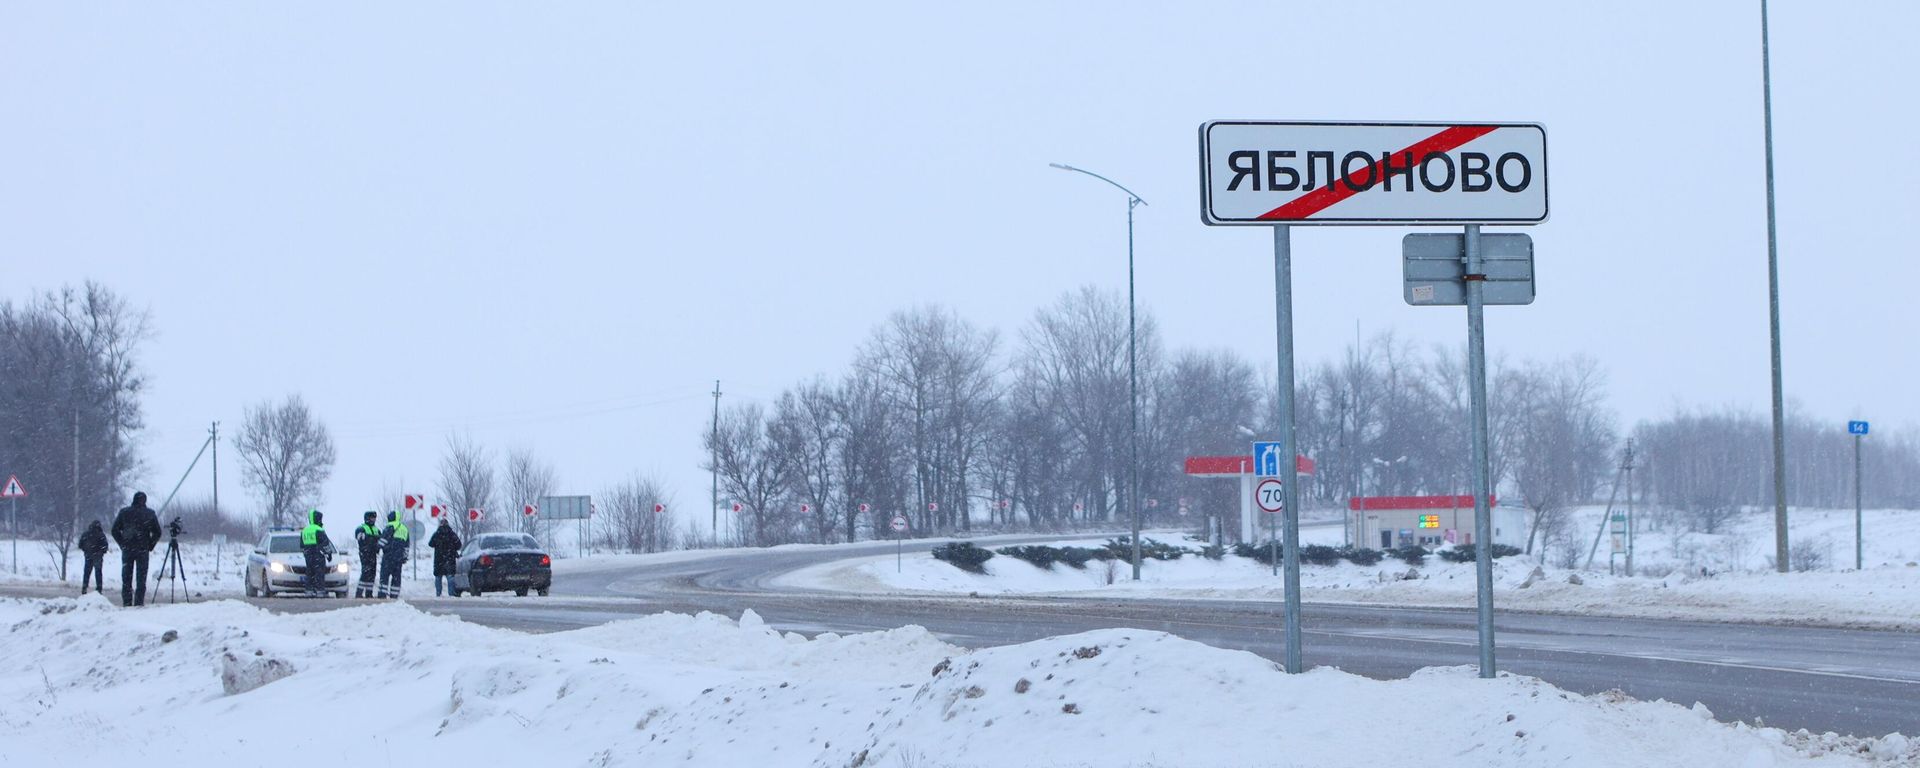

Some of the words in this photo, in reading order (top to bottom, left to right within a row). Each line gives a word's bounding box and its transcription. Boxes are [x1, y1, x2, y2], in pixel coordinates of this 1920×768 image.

[1226, 150, 1532, 193] ЯБЛОНОВО
[1853, 423, 1864, 433] 14
[1263, 489, 1282, 503] 70
